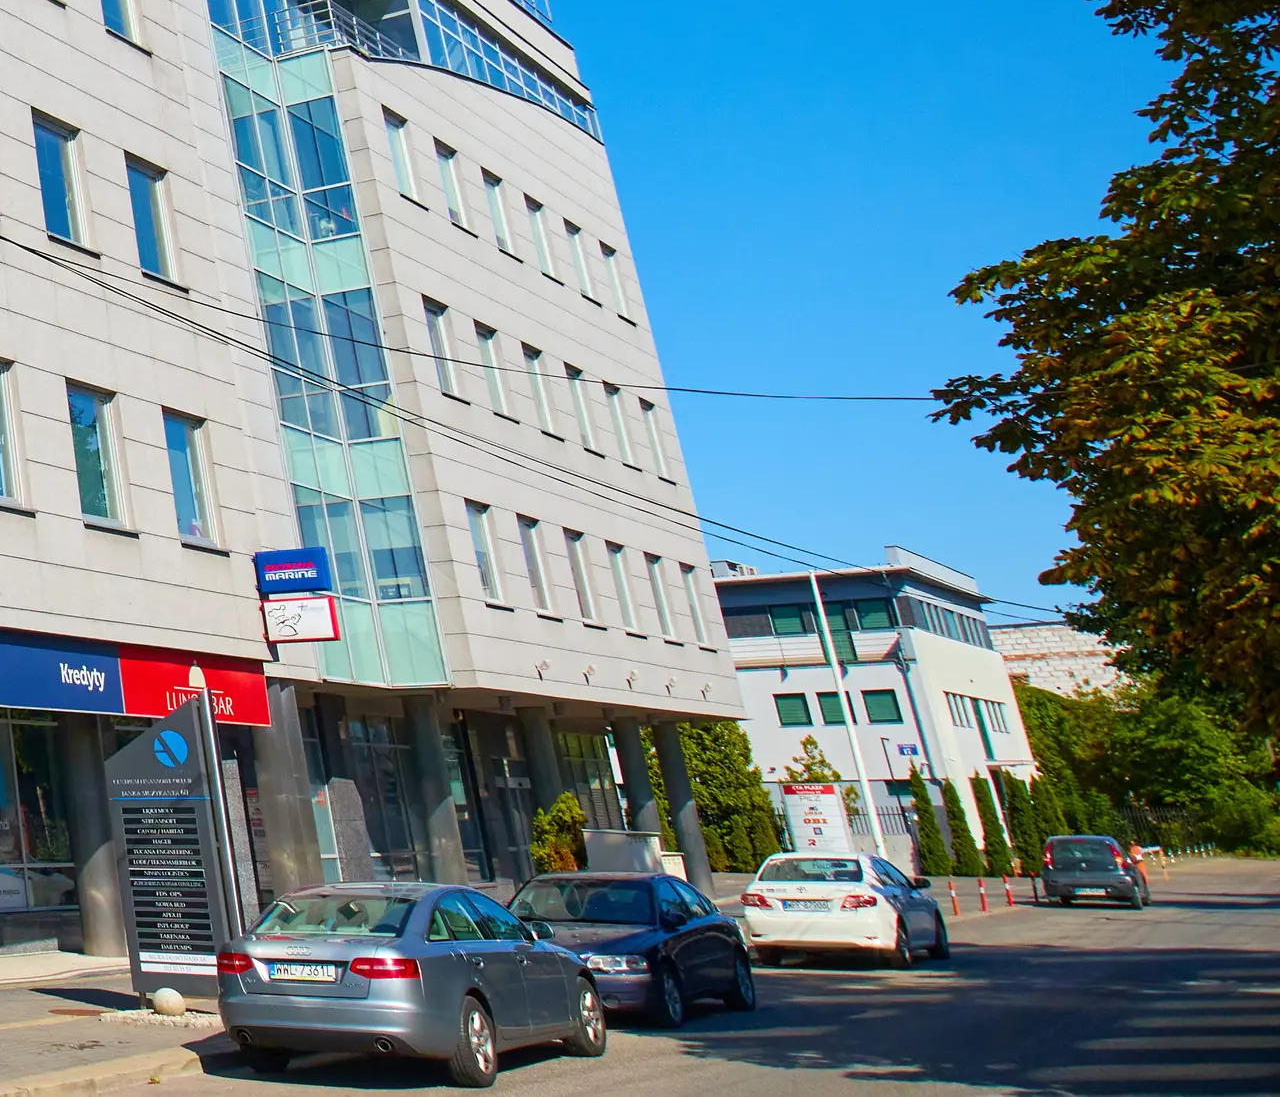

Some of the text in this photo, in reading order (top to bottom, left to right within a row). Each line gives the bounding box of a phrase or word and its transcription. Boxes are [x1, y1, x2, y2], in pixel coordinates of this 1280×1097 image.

[264, 561, 316, 572] HONDA
[265, 570, 318, 581] MARINE
[59, 662, 106, 692] Kredyty
[212, 695, 235, 716] BAR
[275, 964, 333, 978] WWL 7361L
